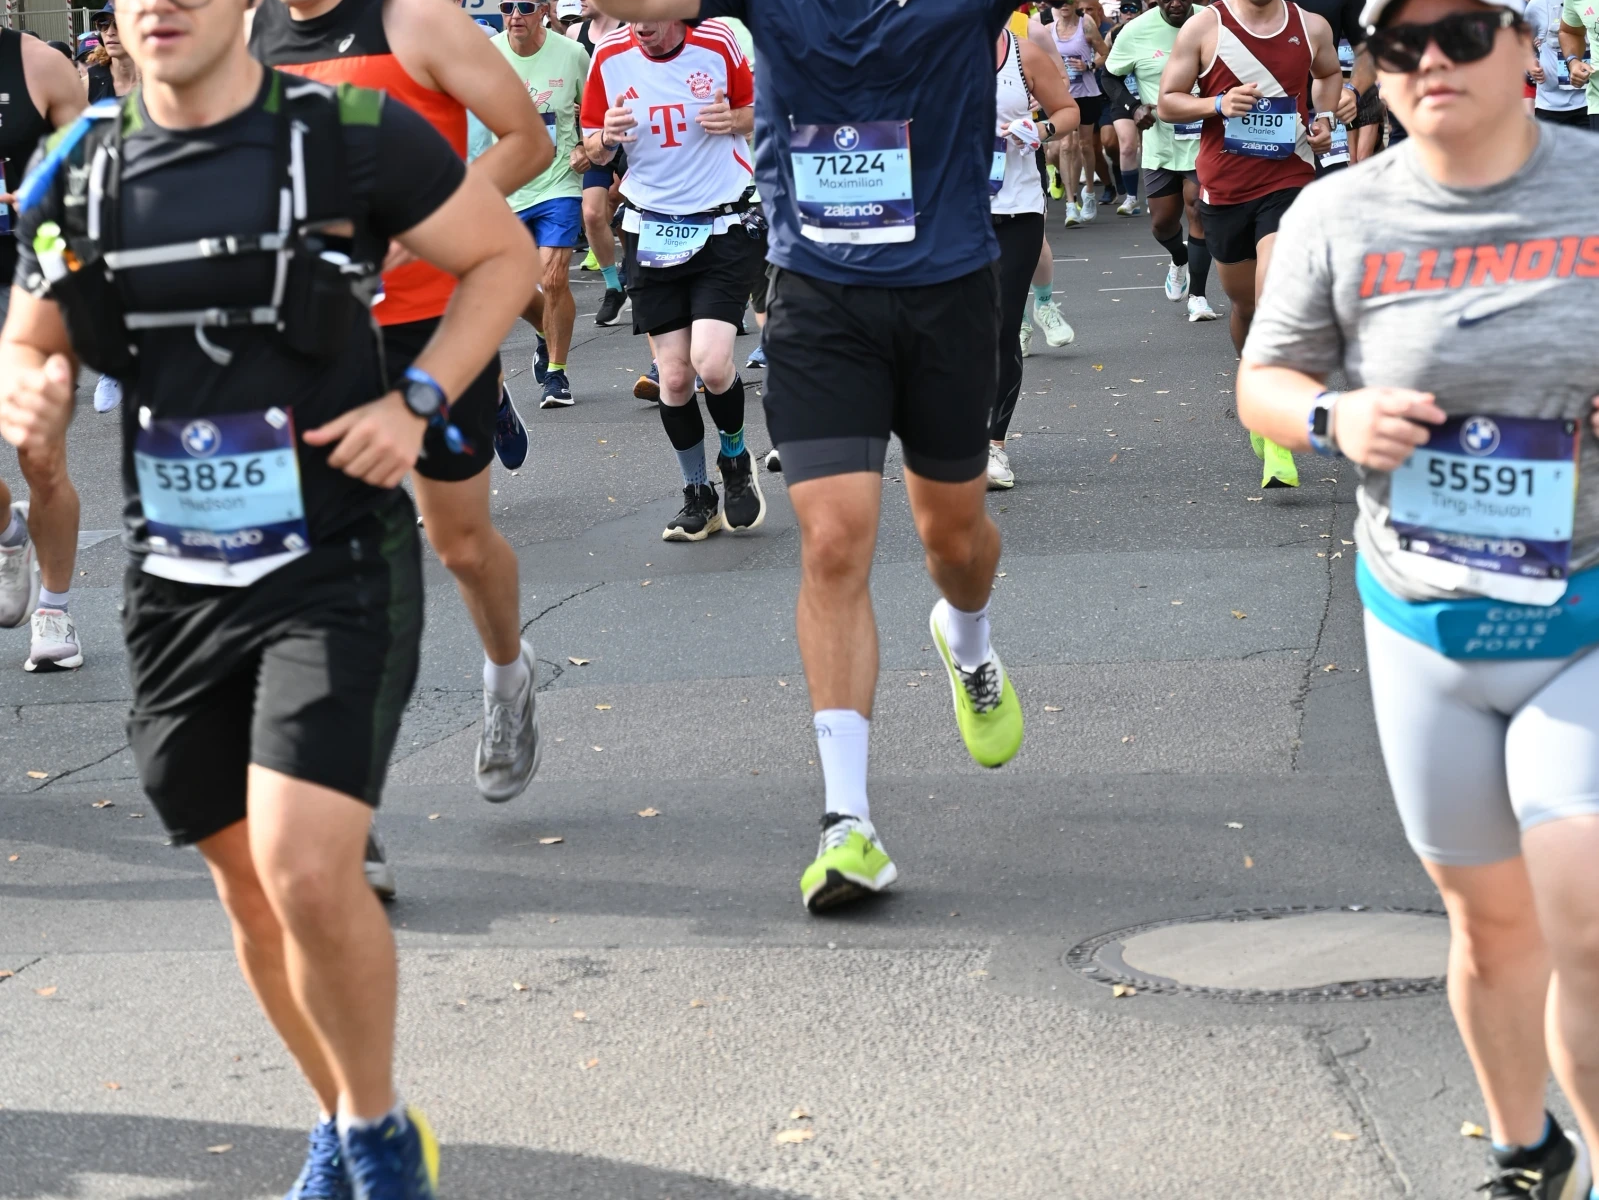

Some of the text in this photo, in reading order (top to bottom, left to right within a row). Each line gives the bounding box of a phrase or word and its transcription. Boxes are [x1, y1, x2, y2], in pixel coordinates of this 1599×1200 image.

[1242, 113, 1283, 127] 61130
[1248, 127, 1276, 135] Charles
[1242, 142, 1279, 151] zalando
[1331, 140, 1348, 150] zalan
[813, 153, 885, 175] 71224
[820, 178, 883, 189] Maximilian
[824, 203, 884, 217] zalando
[656, 224, 699, 238] 26107
[664, 238, 687, 247] Jürgen
[655, 251, 690, 260] zalando
[1359, 235, 1599, 298] ILLINOIS
[154, 457, 266, 492] 53826
[1428, 457, 1535, 496] 55591
